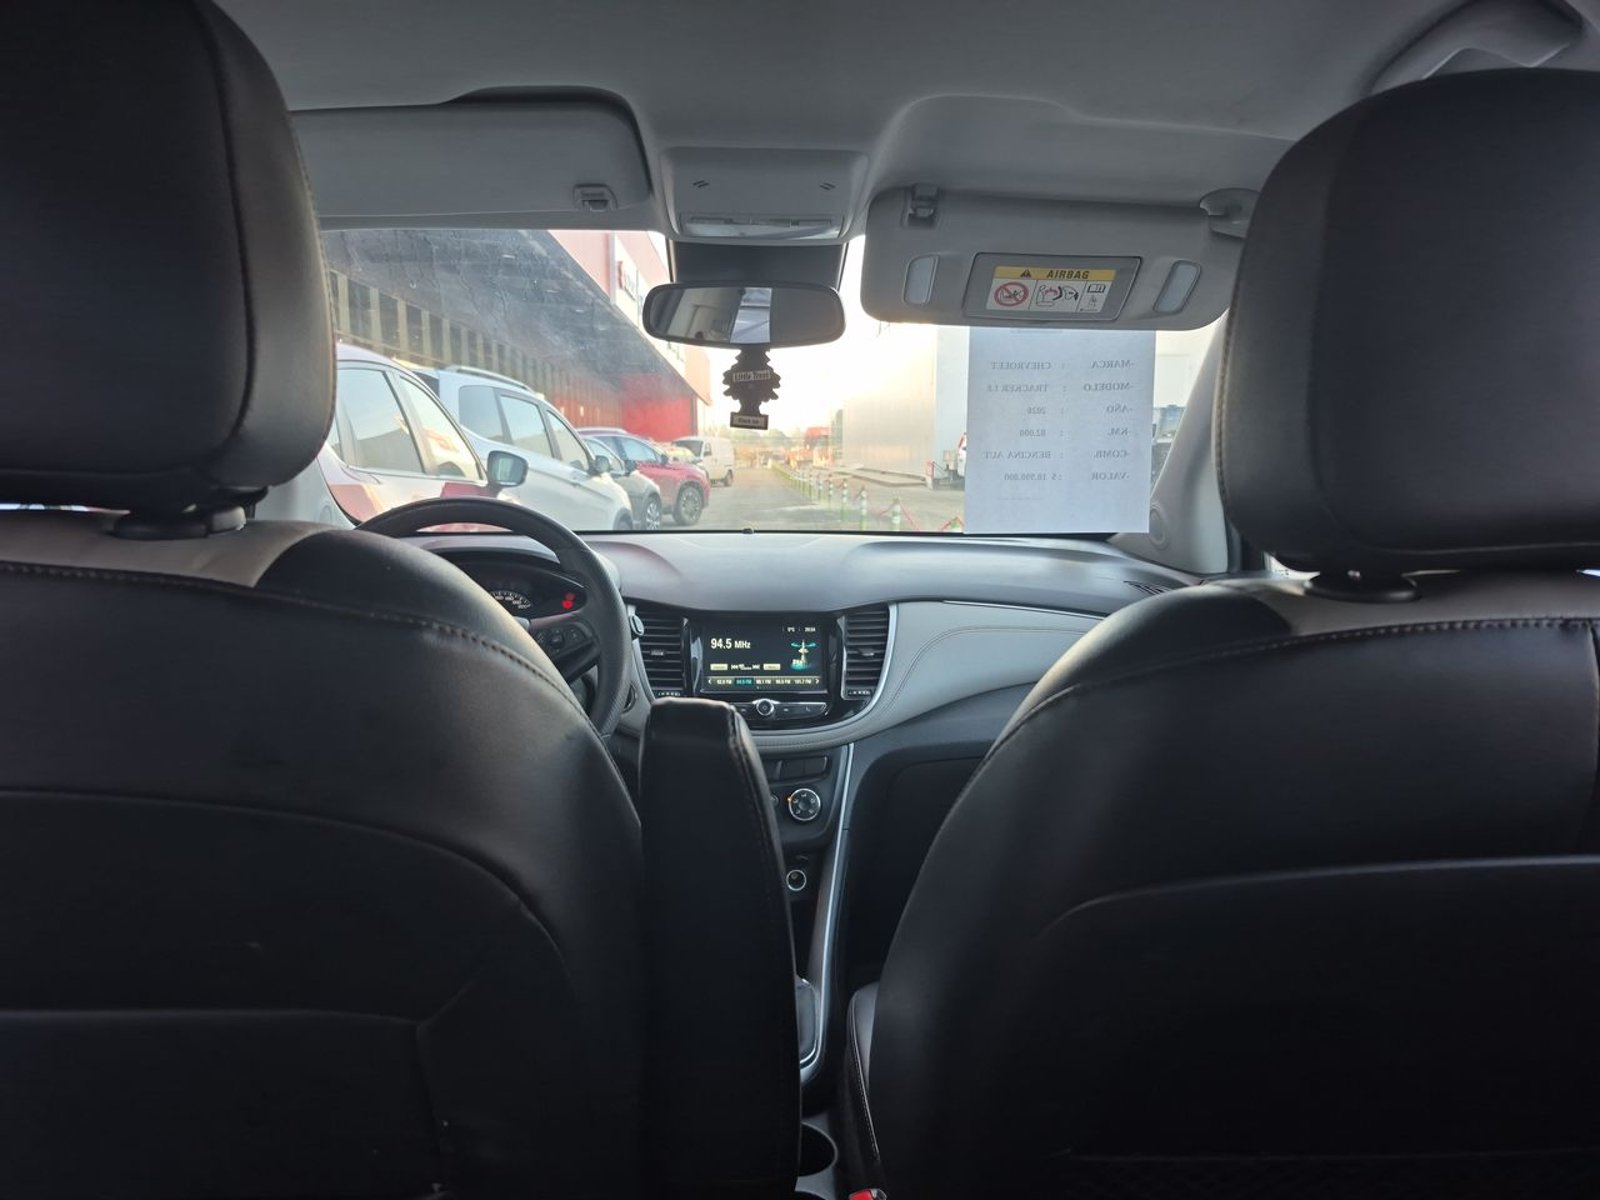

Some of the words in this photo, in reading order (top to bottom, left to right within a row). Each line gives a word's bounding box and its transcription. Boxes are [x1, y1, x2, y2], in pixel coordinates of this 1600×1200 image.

[1046, 269, 1090, 280] AIRBAG
[710, 638, 732, 649] 94.5
[734, 640, 751, 649] MHz
